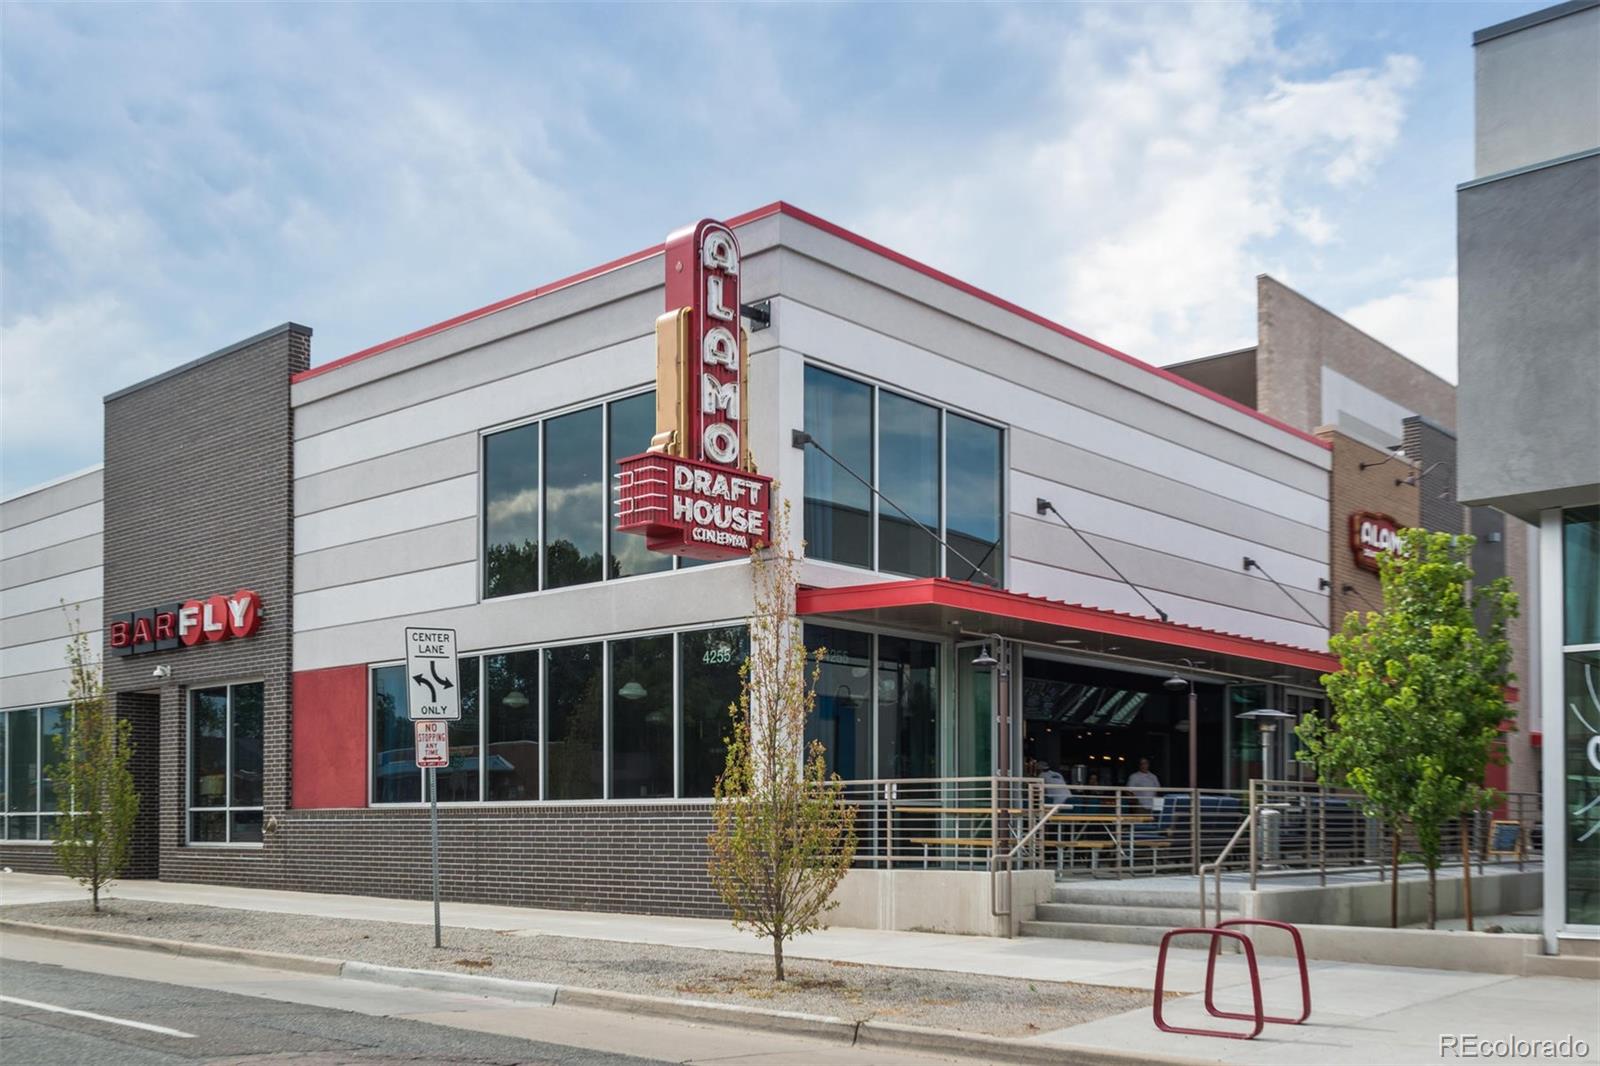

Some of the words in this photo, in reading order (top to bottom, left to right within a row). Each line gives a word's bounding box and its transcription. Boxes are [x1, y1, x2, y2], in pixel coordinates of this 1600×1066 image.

[703, 230, 740, 465] ALAMO
[674, 464, 763, 506] DRAFT
[673, 495, 764, 536] HOUSE
[1361, 521, 1411, 558] ALAM
[412, 632, 450, 643] CENTER
[418, 644, 445, 655] LANE
[702, 648, 732, 664] 4255
[421, 705, 448, 716] ONLY
[425, 723, 438, 733] NO
[418, 732, 446, 743] STOPPING
[425, 742, 438, 750] ANY
[425, 748, 439, 756] TIME
